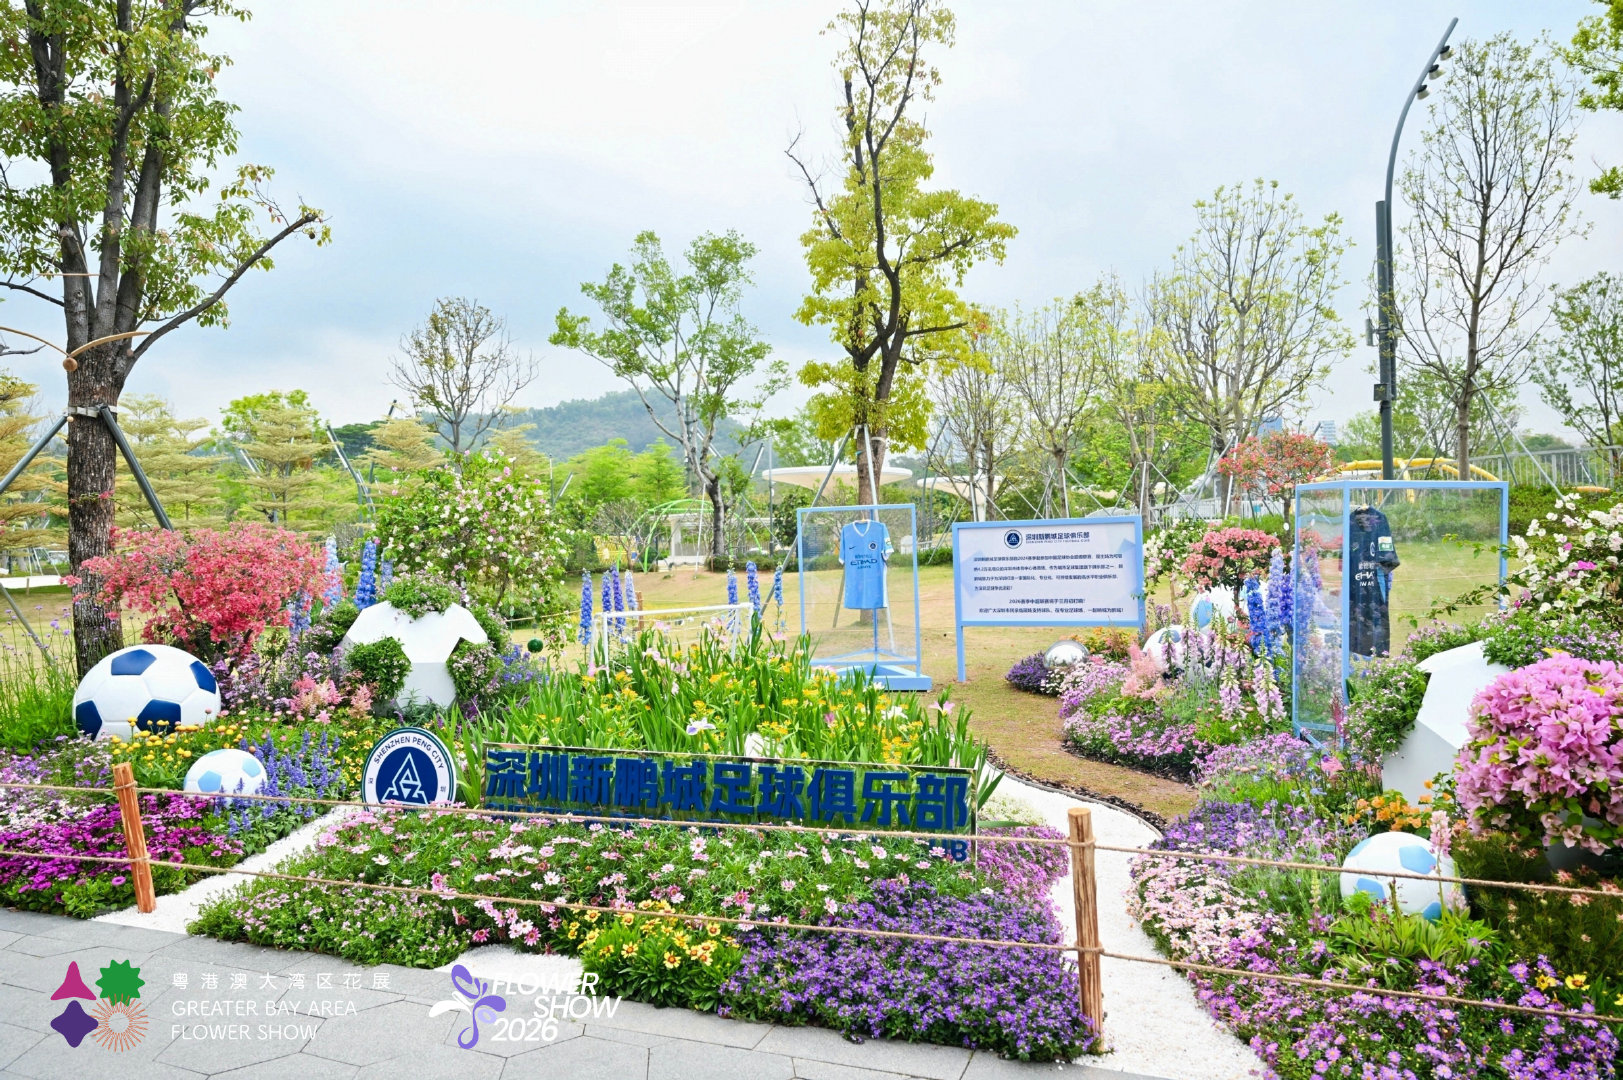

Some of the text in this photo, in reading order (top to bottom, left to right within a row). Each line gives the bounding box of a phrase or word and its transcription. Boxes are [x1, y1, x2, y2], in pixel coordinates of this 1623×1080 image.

[374, 736, 444, 769] SHENZHEN PENG CITY
[486, 750, 969, 830] 深圳新鹏城足球俱乐部
